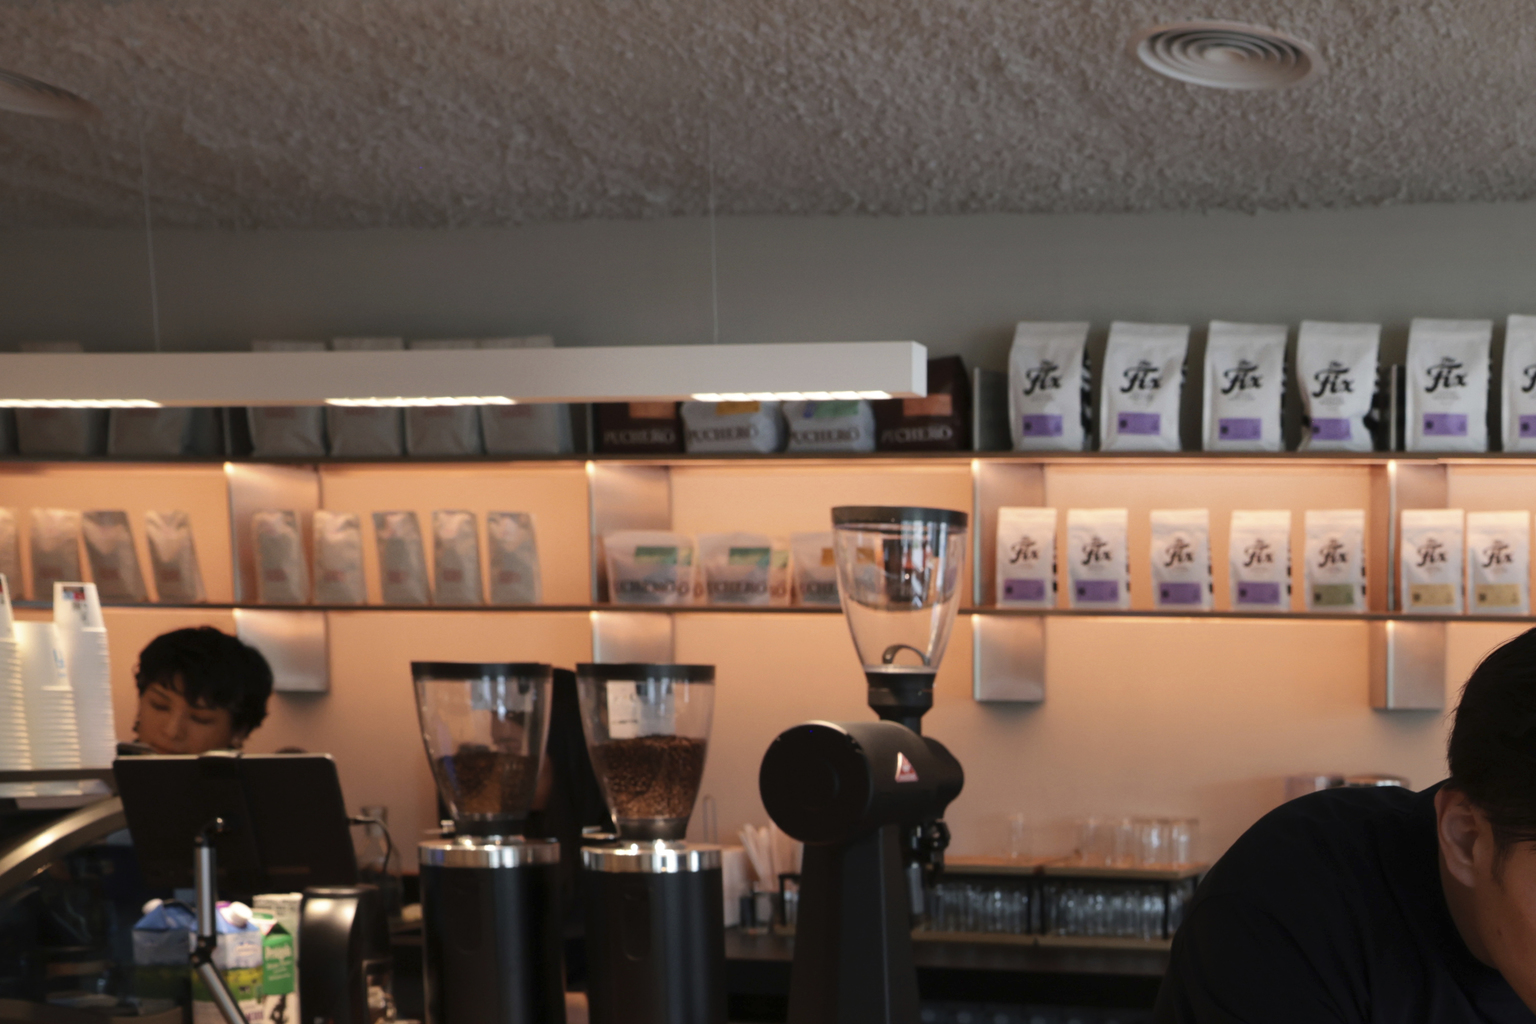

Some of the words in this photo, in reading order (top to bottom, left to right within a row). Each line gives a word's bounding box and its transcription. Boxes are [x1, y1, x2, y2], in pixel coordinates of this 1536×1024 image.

[1023, 363, 1062, 396] Fix
[1120, 364, 1162, 394] Fix
[1221, 364, 1262, 395] Fix
[1312, 365, 1354, 397] Fix
[1425, 362, 1468, 393] Fix
